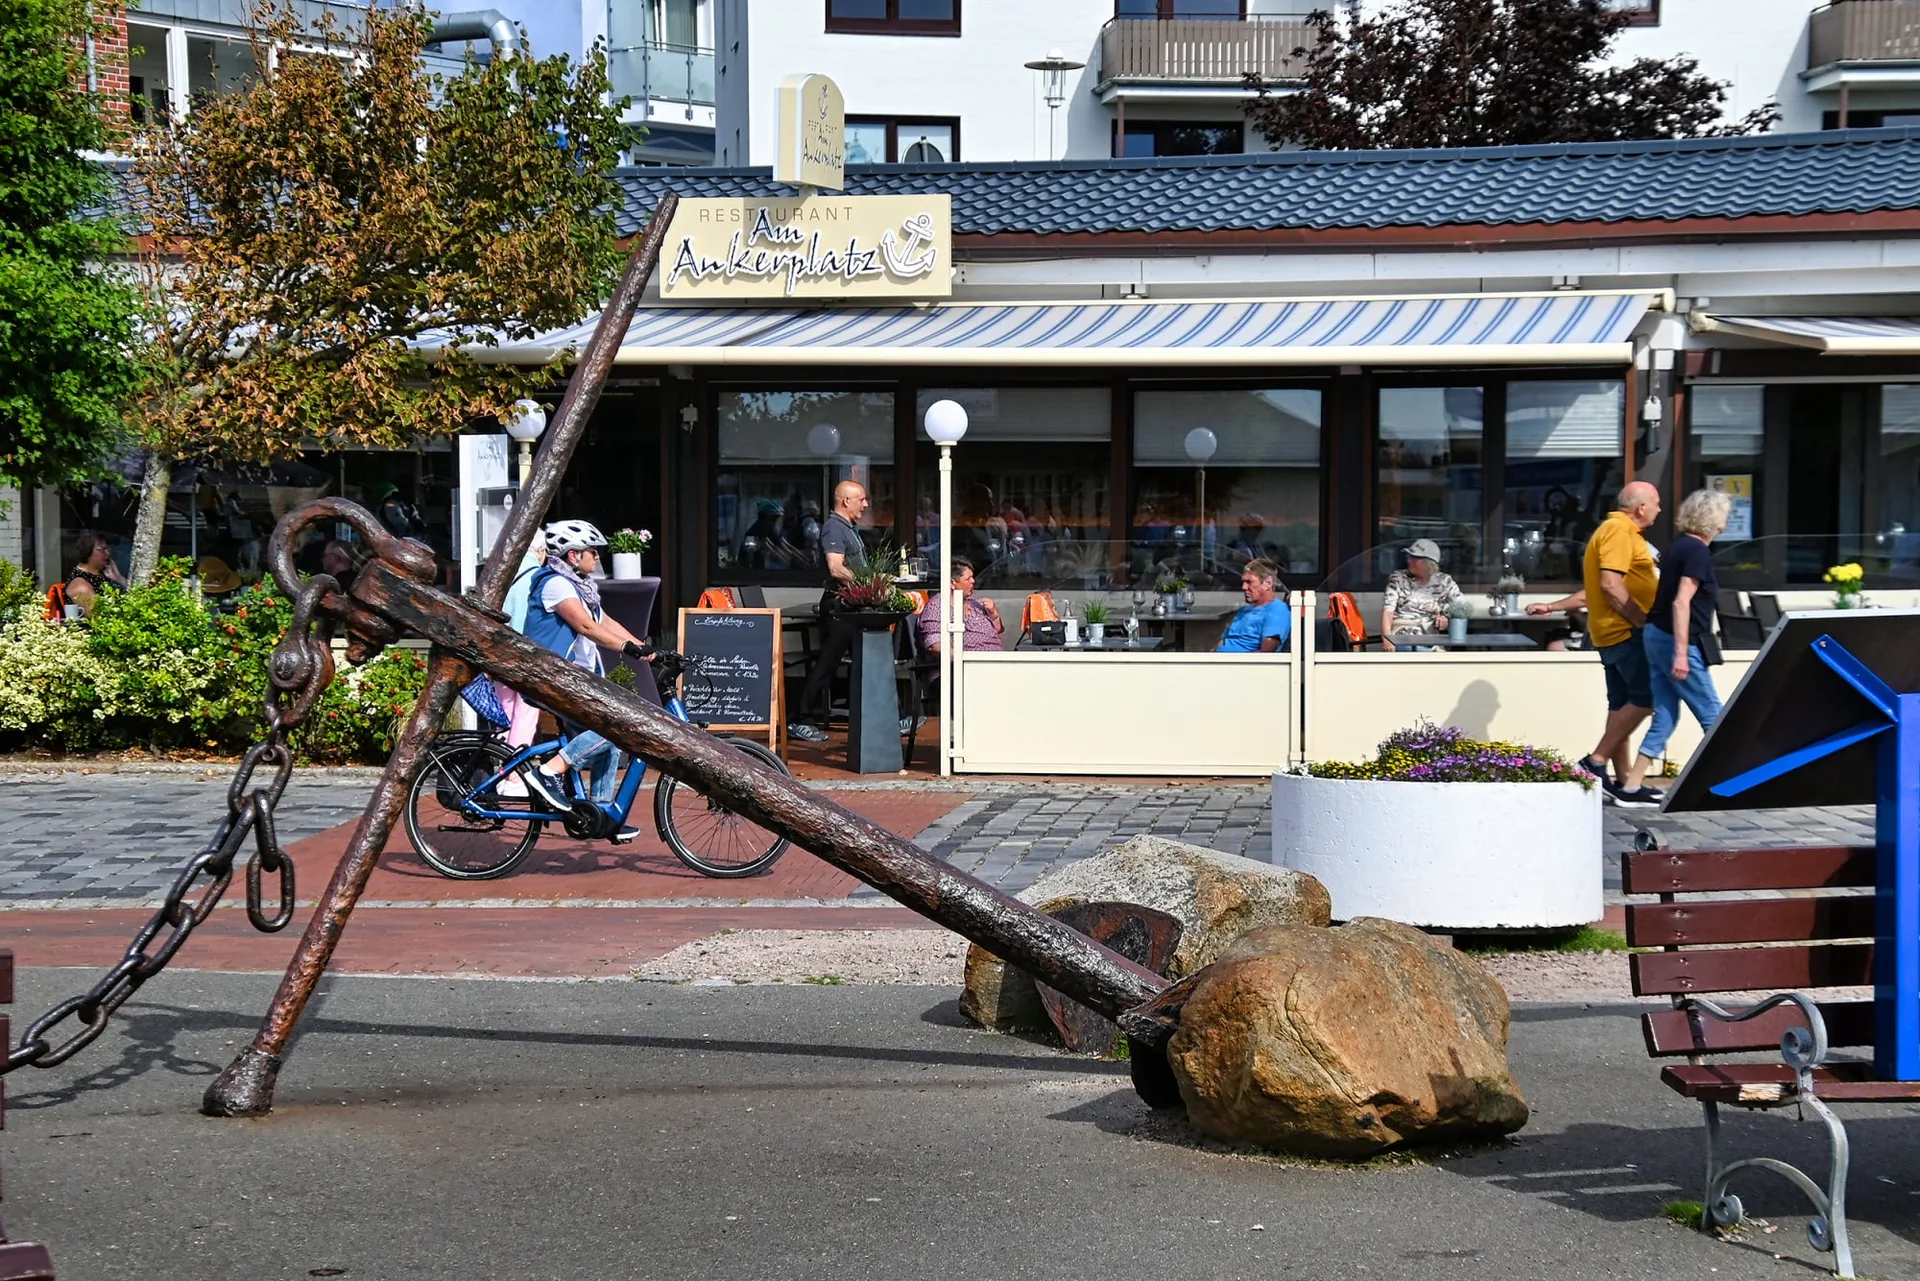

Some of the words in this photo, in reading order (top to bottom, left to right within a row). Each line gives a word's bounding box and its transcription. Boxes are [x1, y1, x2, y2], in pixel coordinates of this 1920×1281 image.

[699, 206, 854, 223] RESTURANT
[748, 206, 804, 244] Am
[668, 231, 885, 295] Ankerplatz
